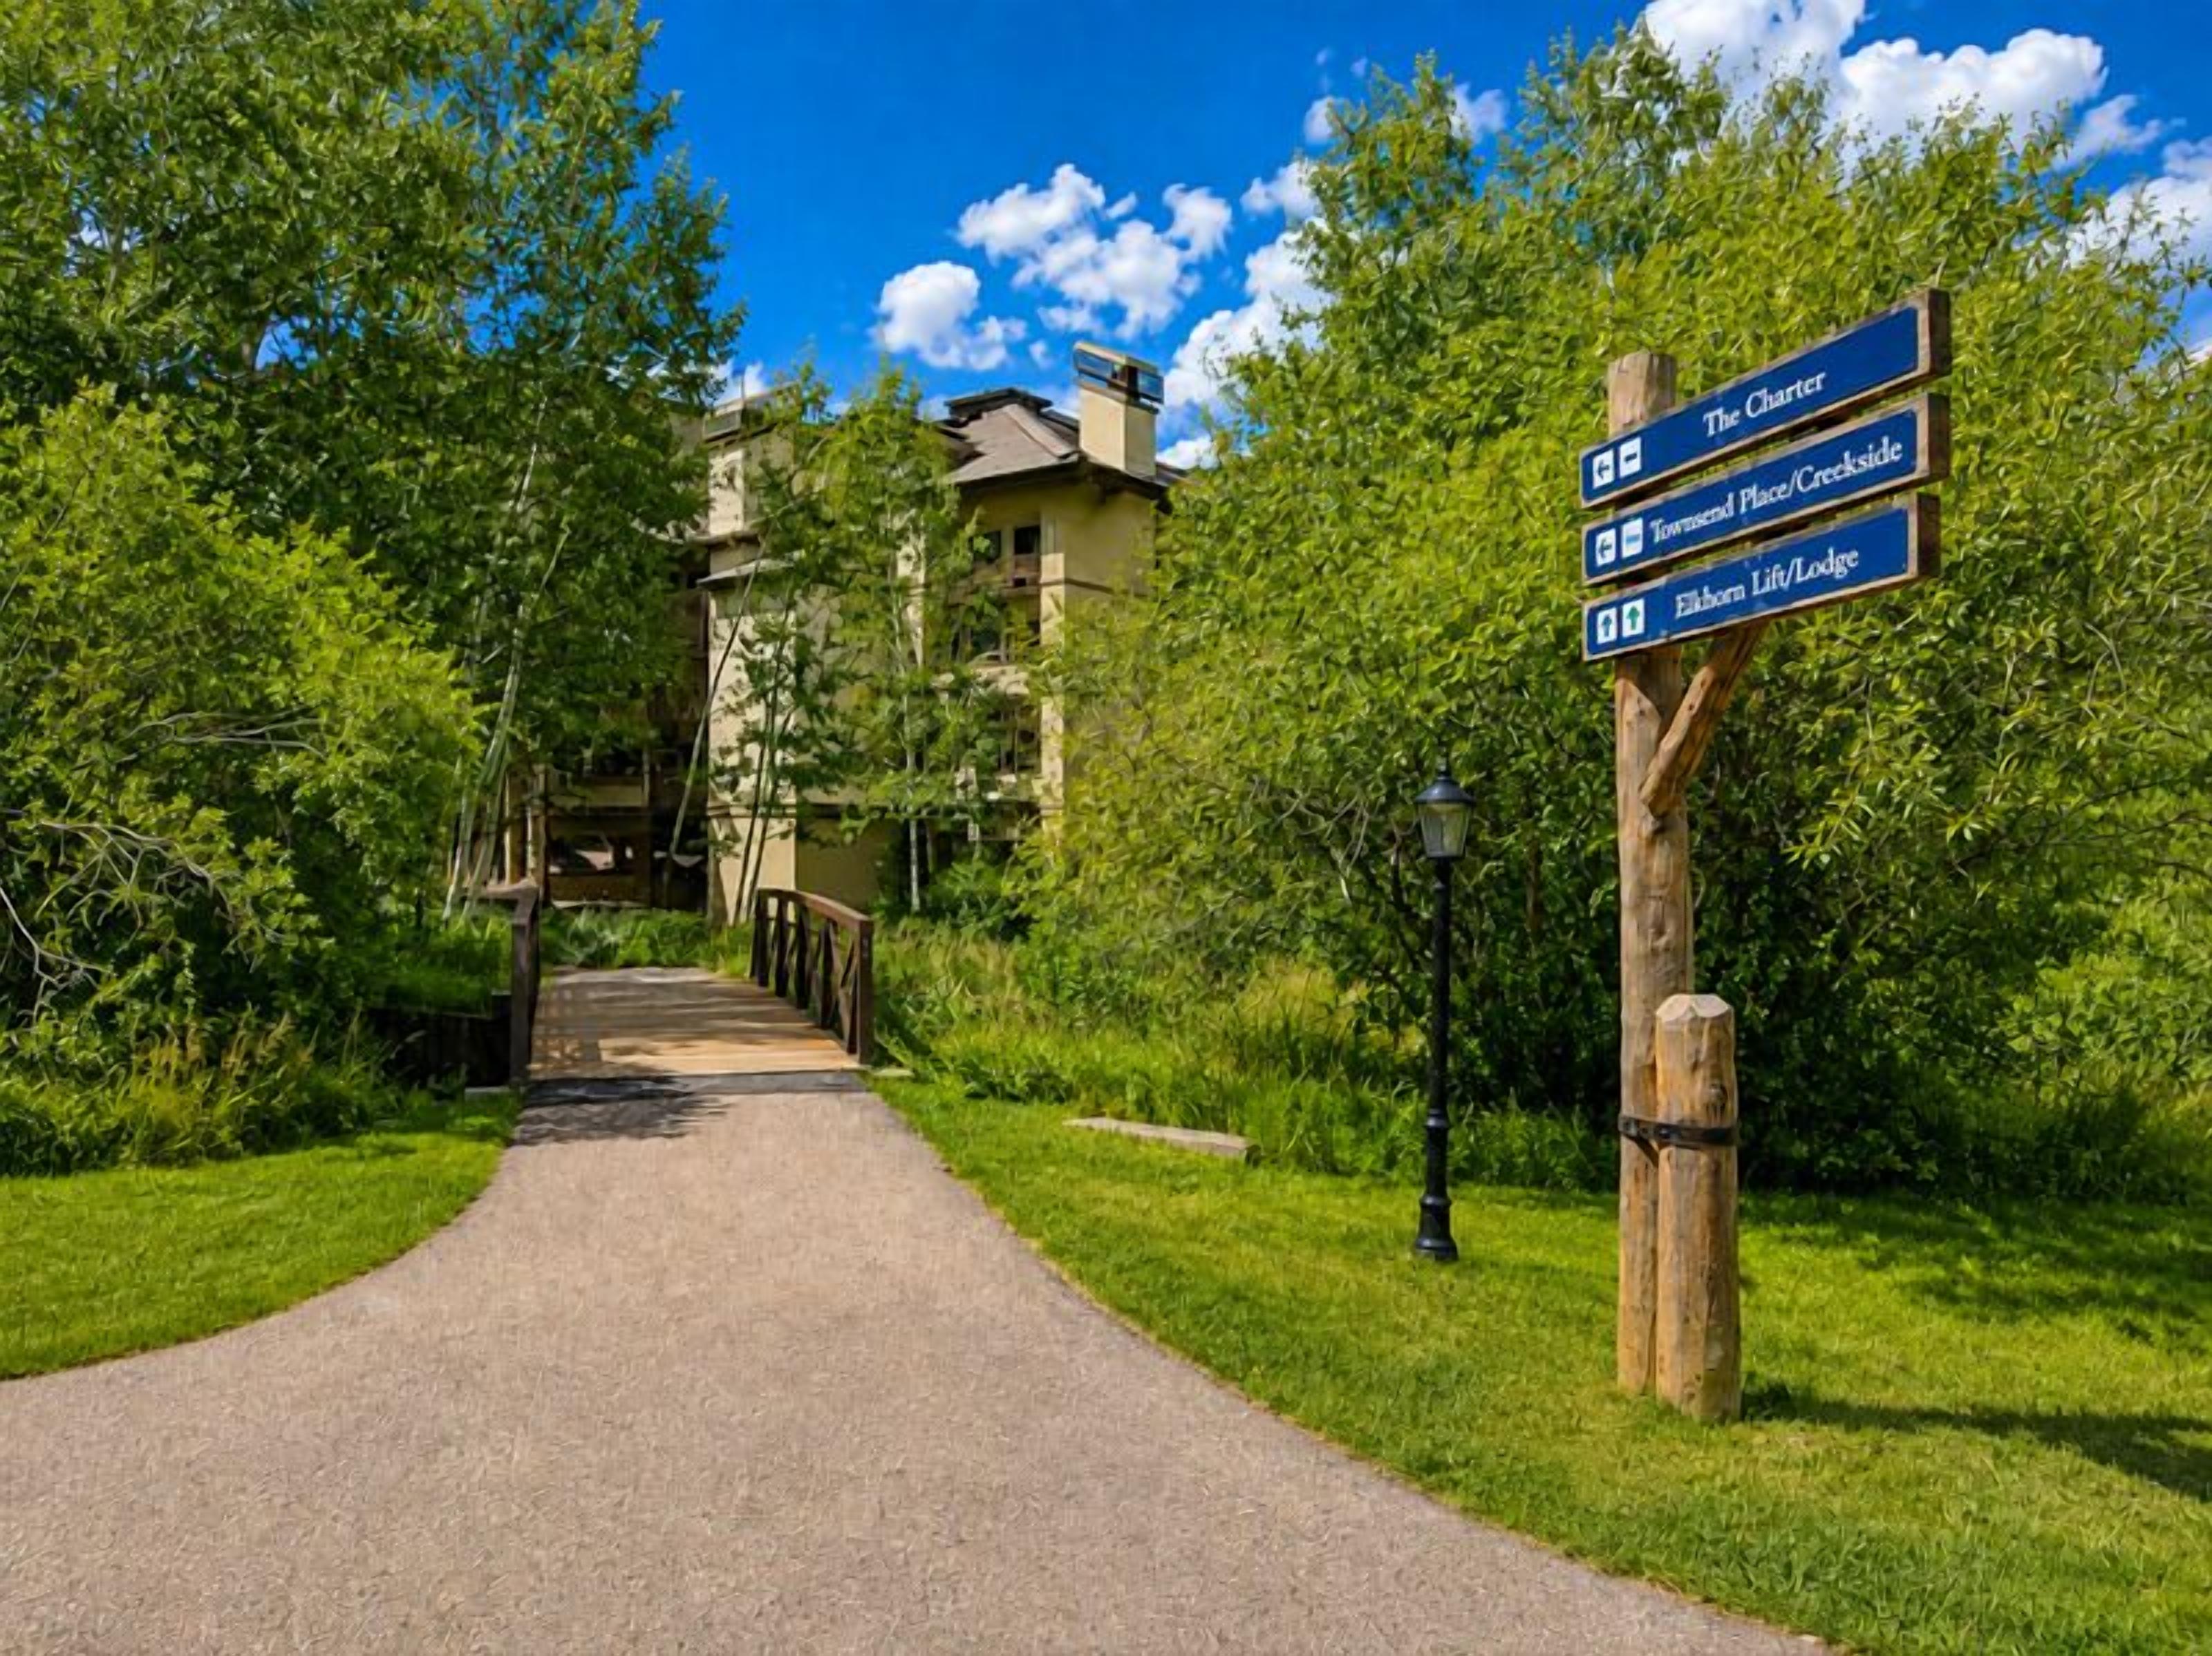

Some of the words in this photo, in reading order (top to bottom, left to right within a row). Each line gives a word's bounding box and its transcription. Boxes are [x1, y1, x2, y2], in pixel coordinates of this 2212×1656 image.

[1703, 410, 1739, 437] The
[1745, 370, 1826, 415] Charter
[1650, 493, 1734, 543] Townsend
[1739, 435, 1903, 514] Place/Creekside
[1676, 582, 1745, 619] Elkhorn
[1752, 547, 1859, 598] Lift/Lodge
